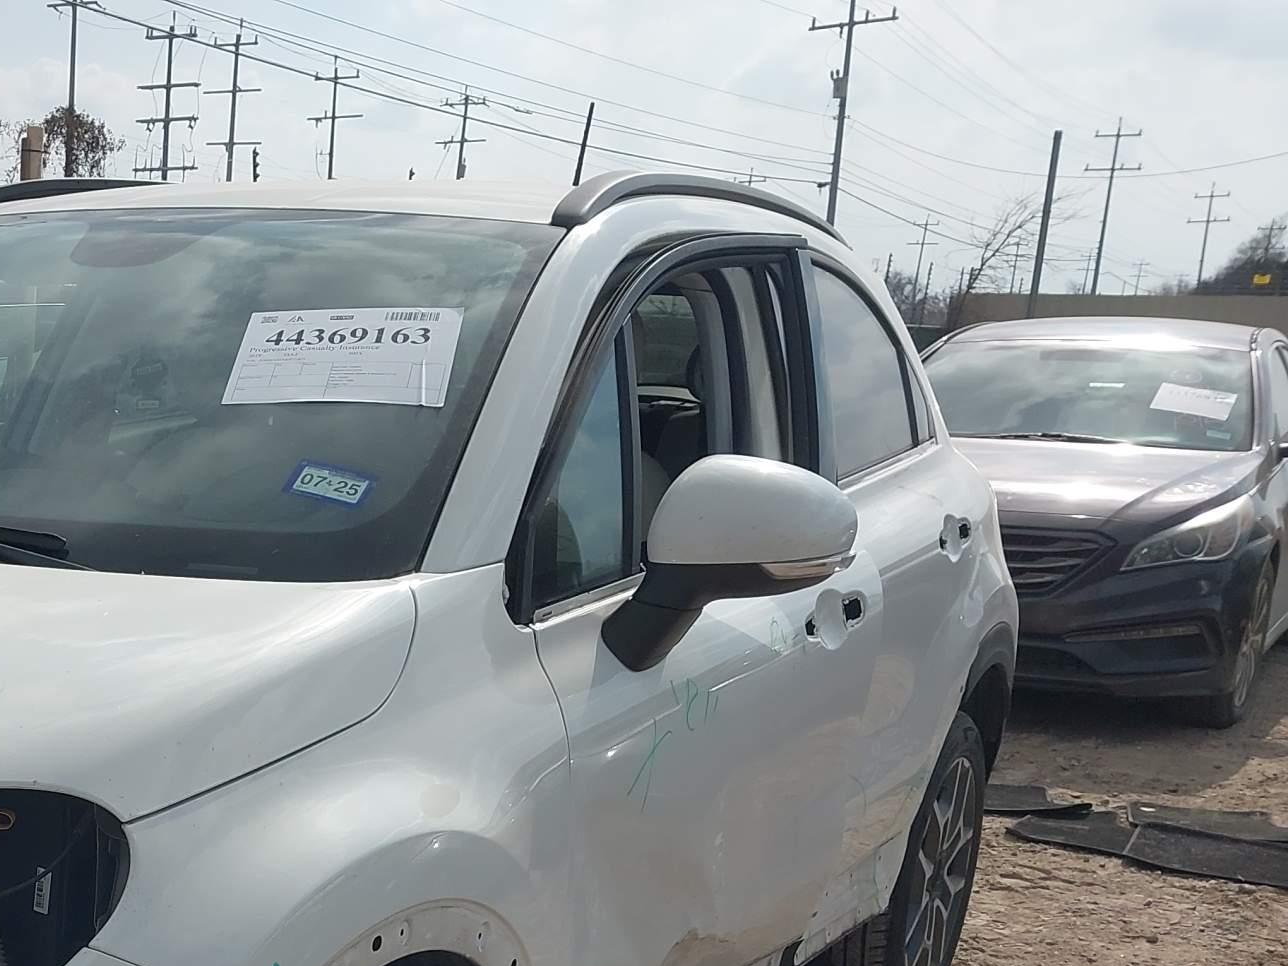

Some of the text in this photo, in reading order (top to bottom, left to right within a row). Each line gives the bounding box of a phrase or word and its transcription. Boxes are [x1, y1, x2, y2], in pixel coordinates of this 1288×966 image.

[265, 327, 431, 346] 44369163
[300, 473, 361, 496] 07 25
